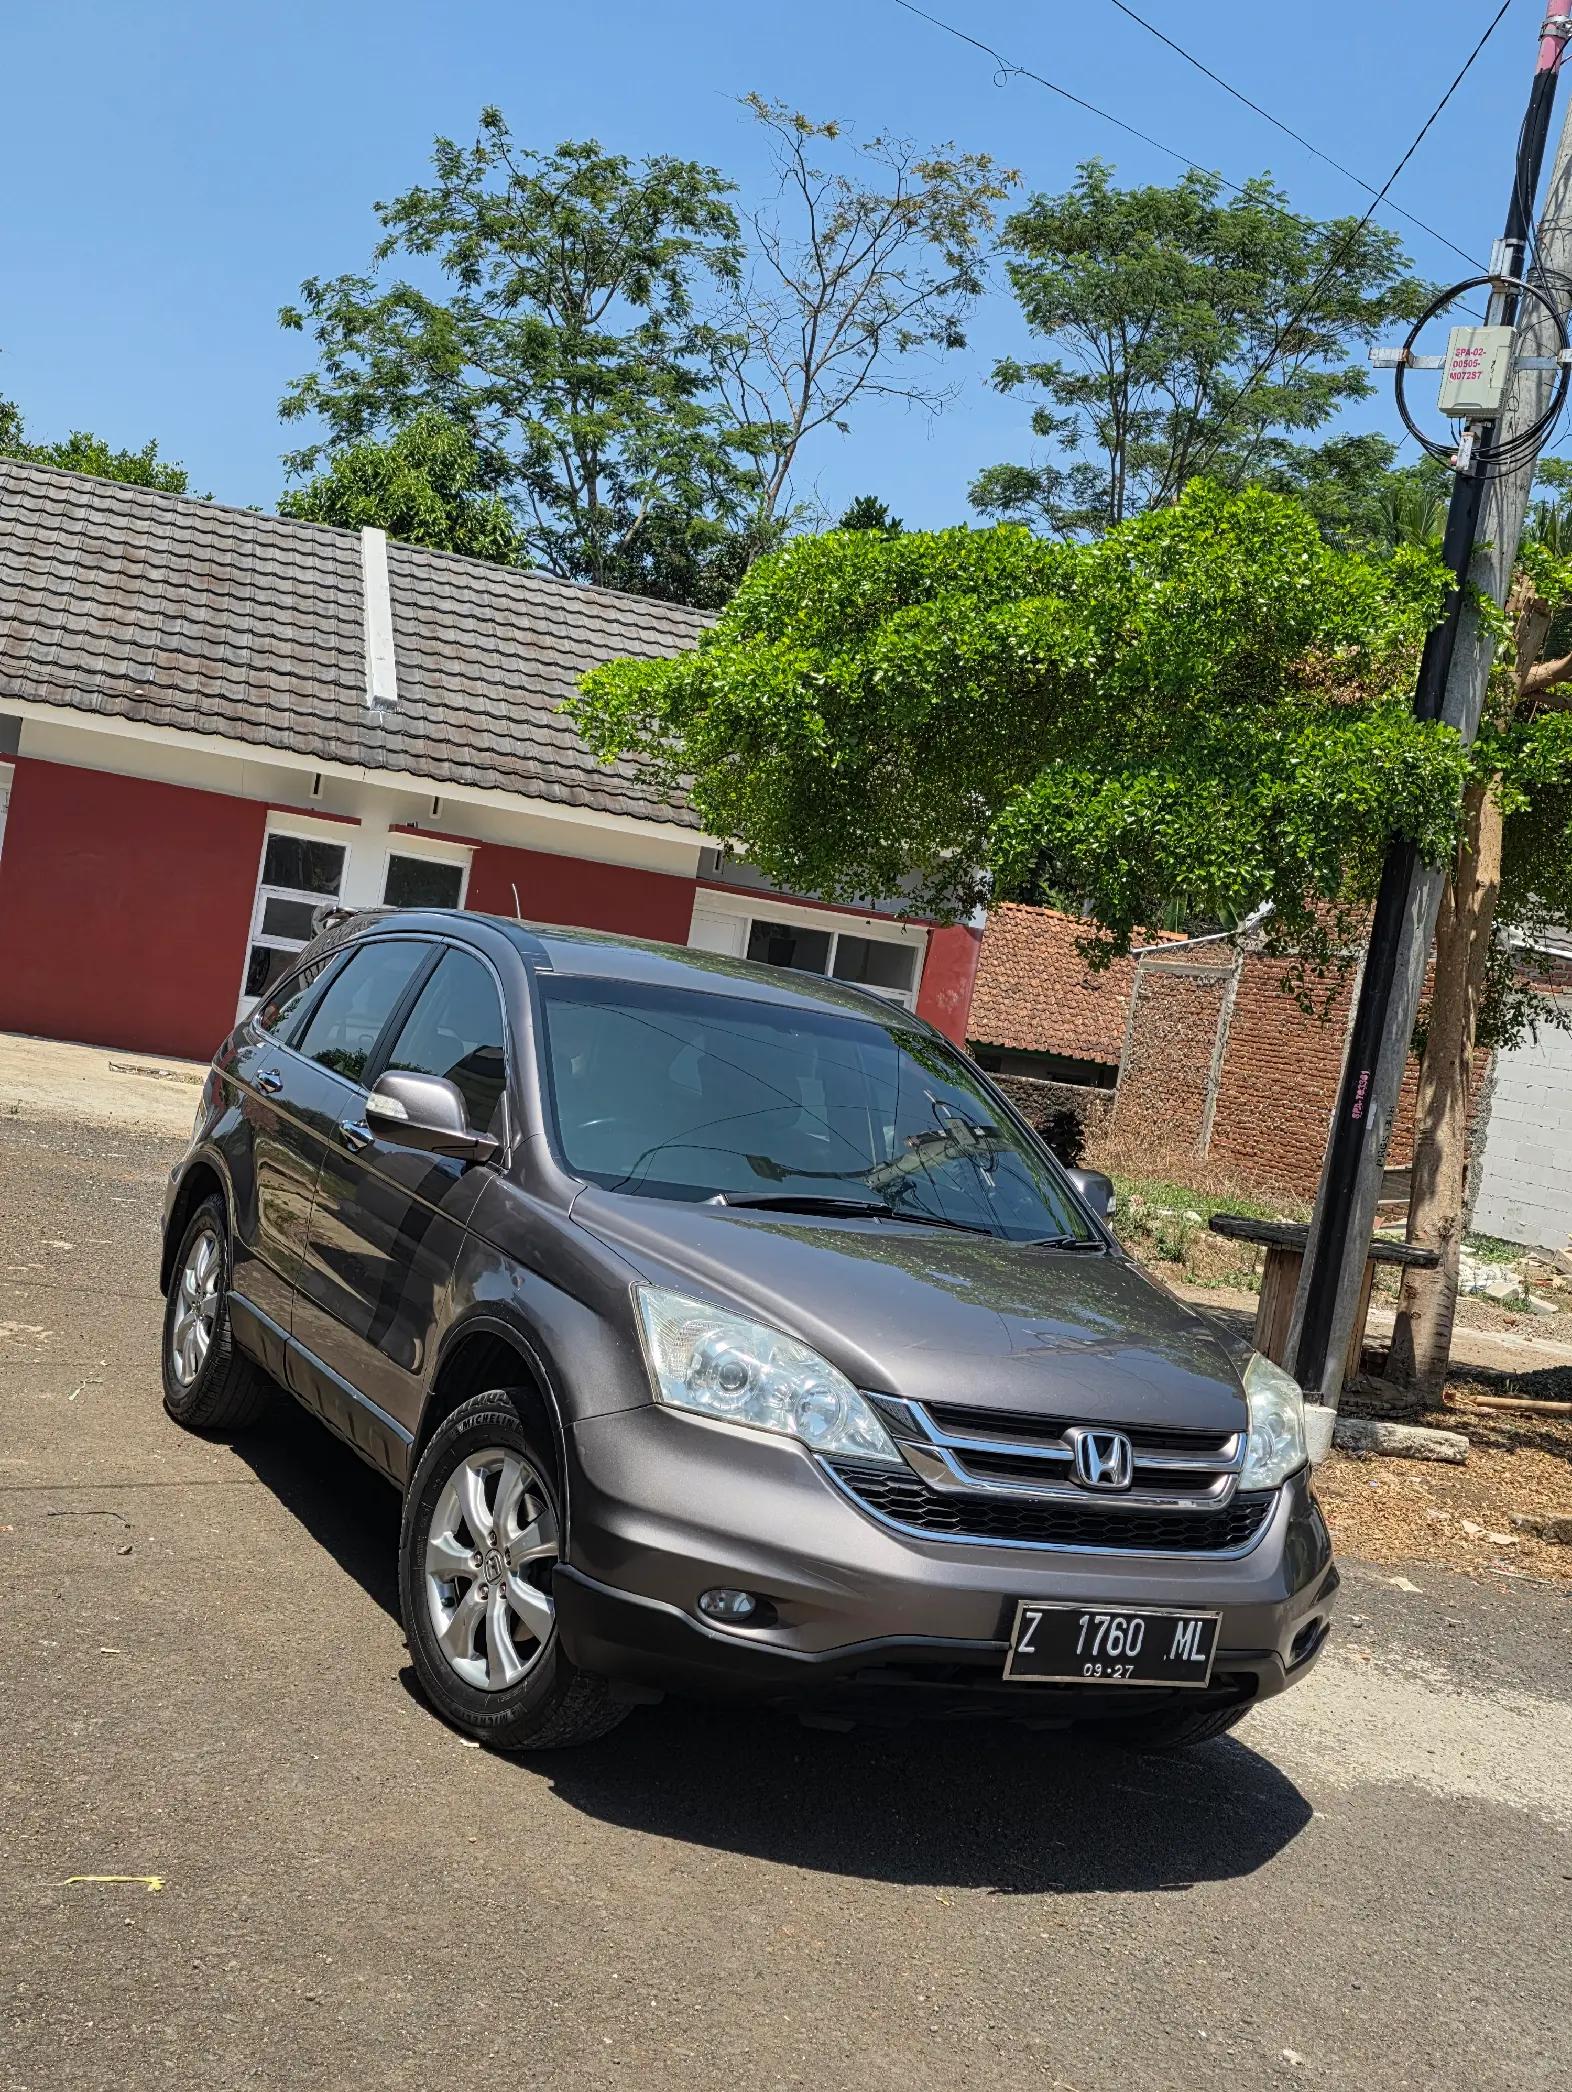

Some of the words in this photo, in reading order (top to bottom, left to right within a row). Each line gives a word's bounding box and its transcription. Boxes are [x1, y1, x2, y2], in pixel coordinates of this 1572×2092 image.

[462, 1411, 514, 1431] MICHELIN
[1018, 1611, 1043, 1653] Z
[1076, 1614, 1145, 1657] 1760
[1169, 1620, 1206, 1661] ML
